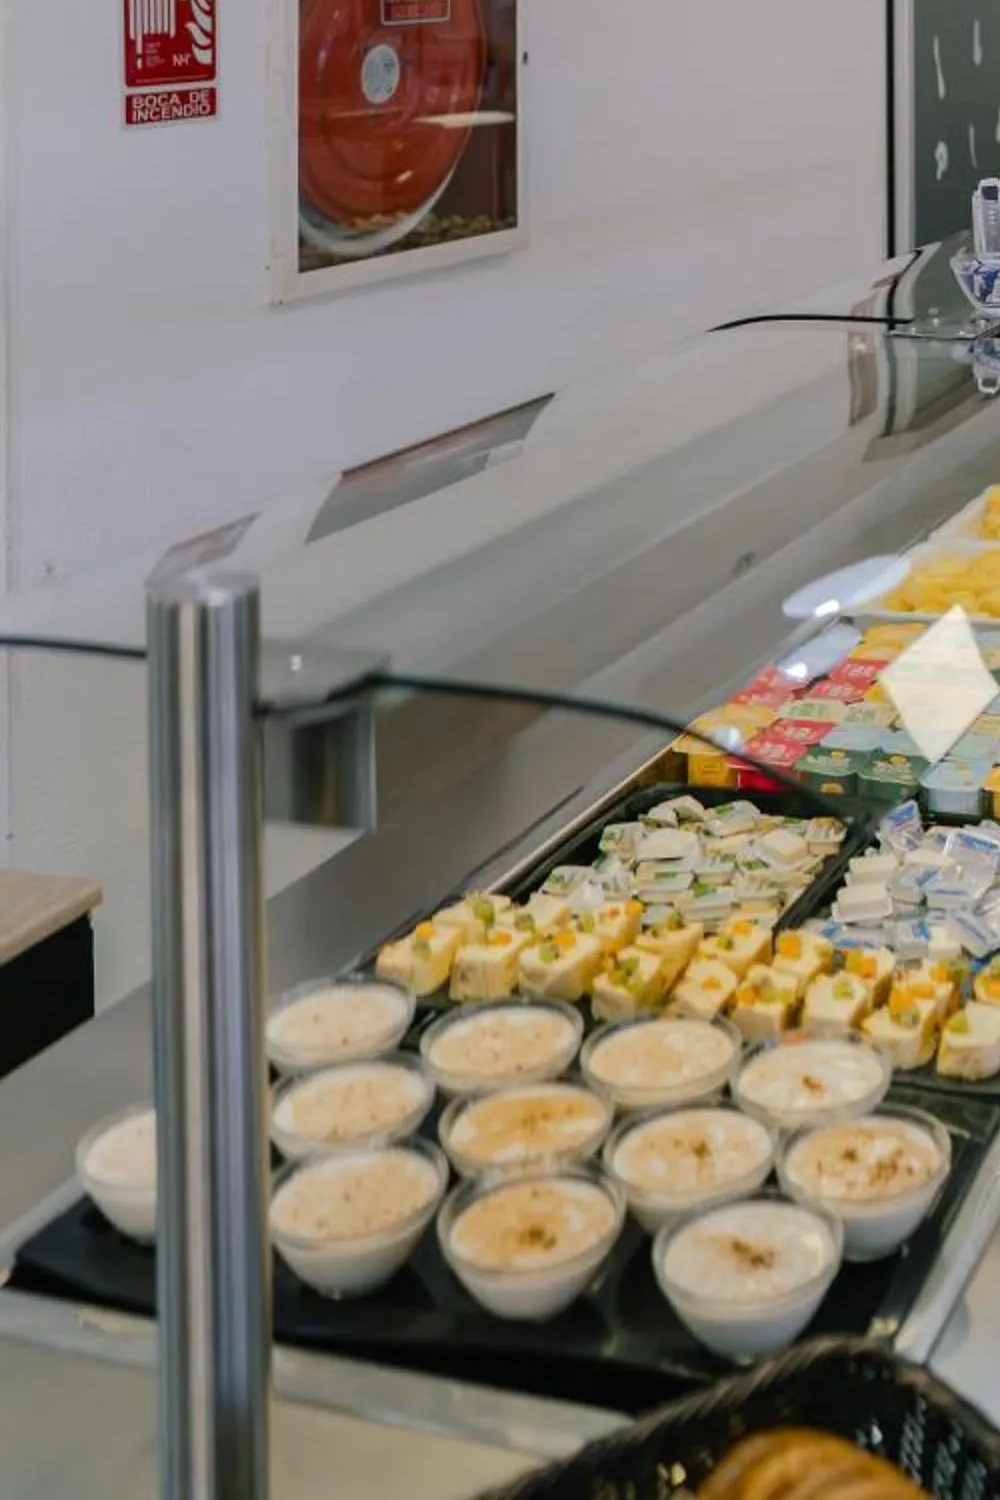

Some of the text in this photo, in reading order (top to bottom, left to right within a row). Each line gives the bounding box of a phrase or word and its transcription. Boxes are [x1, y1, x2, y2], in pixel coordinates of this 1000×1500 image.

[132, 90, 210, 109] BOCA DE
[132, 103, 211, 122] INCENDIO
